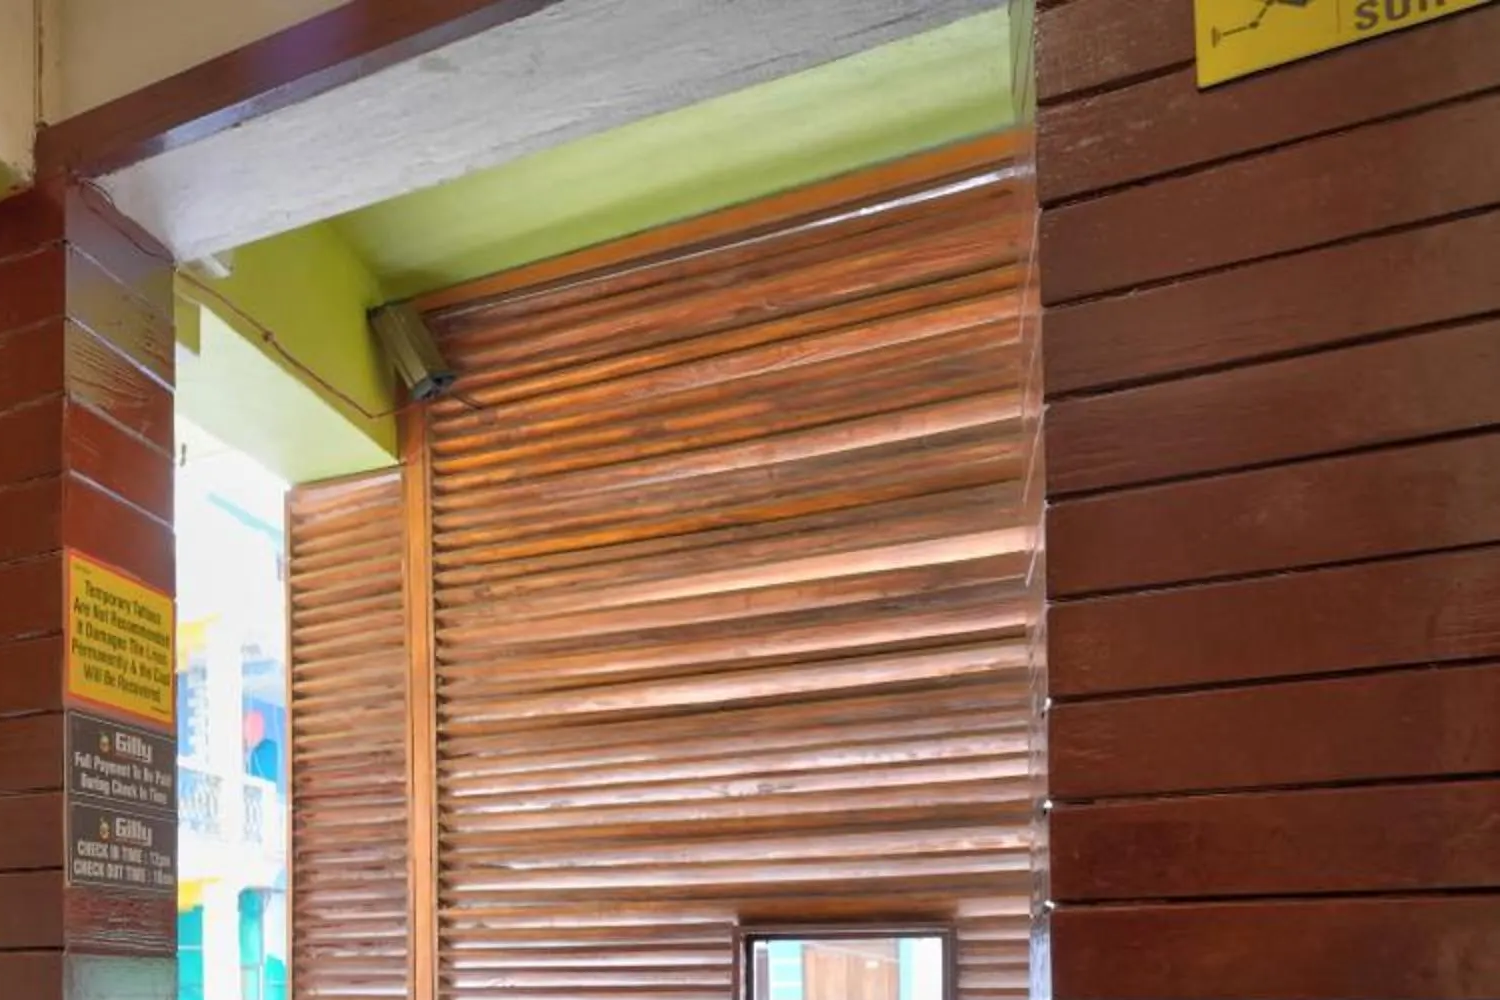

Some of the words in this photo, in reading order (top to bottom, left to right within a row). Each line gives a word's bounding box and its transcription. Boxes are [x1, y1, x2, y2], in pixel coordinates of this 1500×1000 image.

[86, 622, 128, 651] Damages
[115, 732, 153, 763] Gilly
[74, 752, 92, 770] Full
[94, 756, 131, 780] Payment
[81, 773, 110, 796] During
[112, 780, 138, 799] Check
[115, 817, 153, 847] Gilly
[78, 840, 109, 858] CHECK
[122, 847, 143, 863] TIME
[74, 861, 105, 877] CHECK
[107, 864, 123, 880] OUT
[125, 866, 146, 883] TIME
